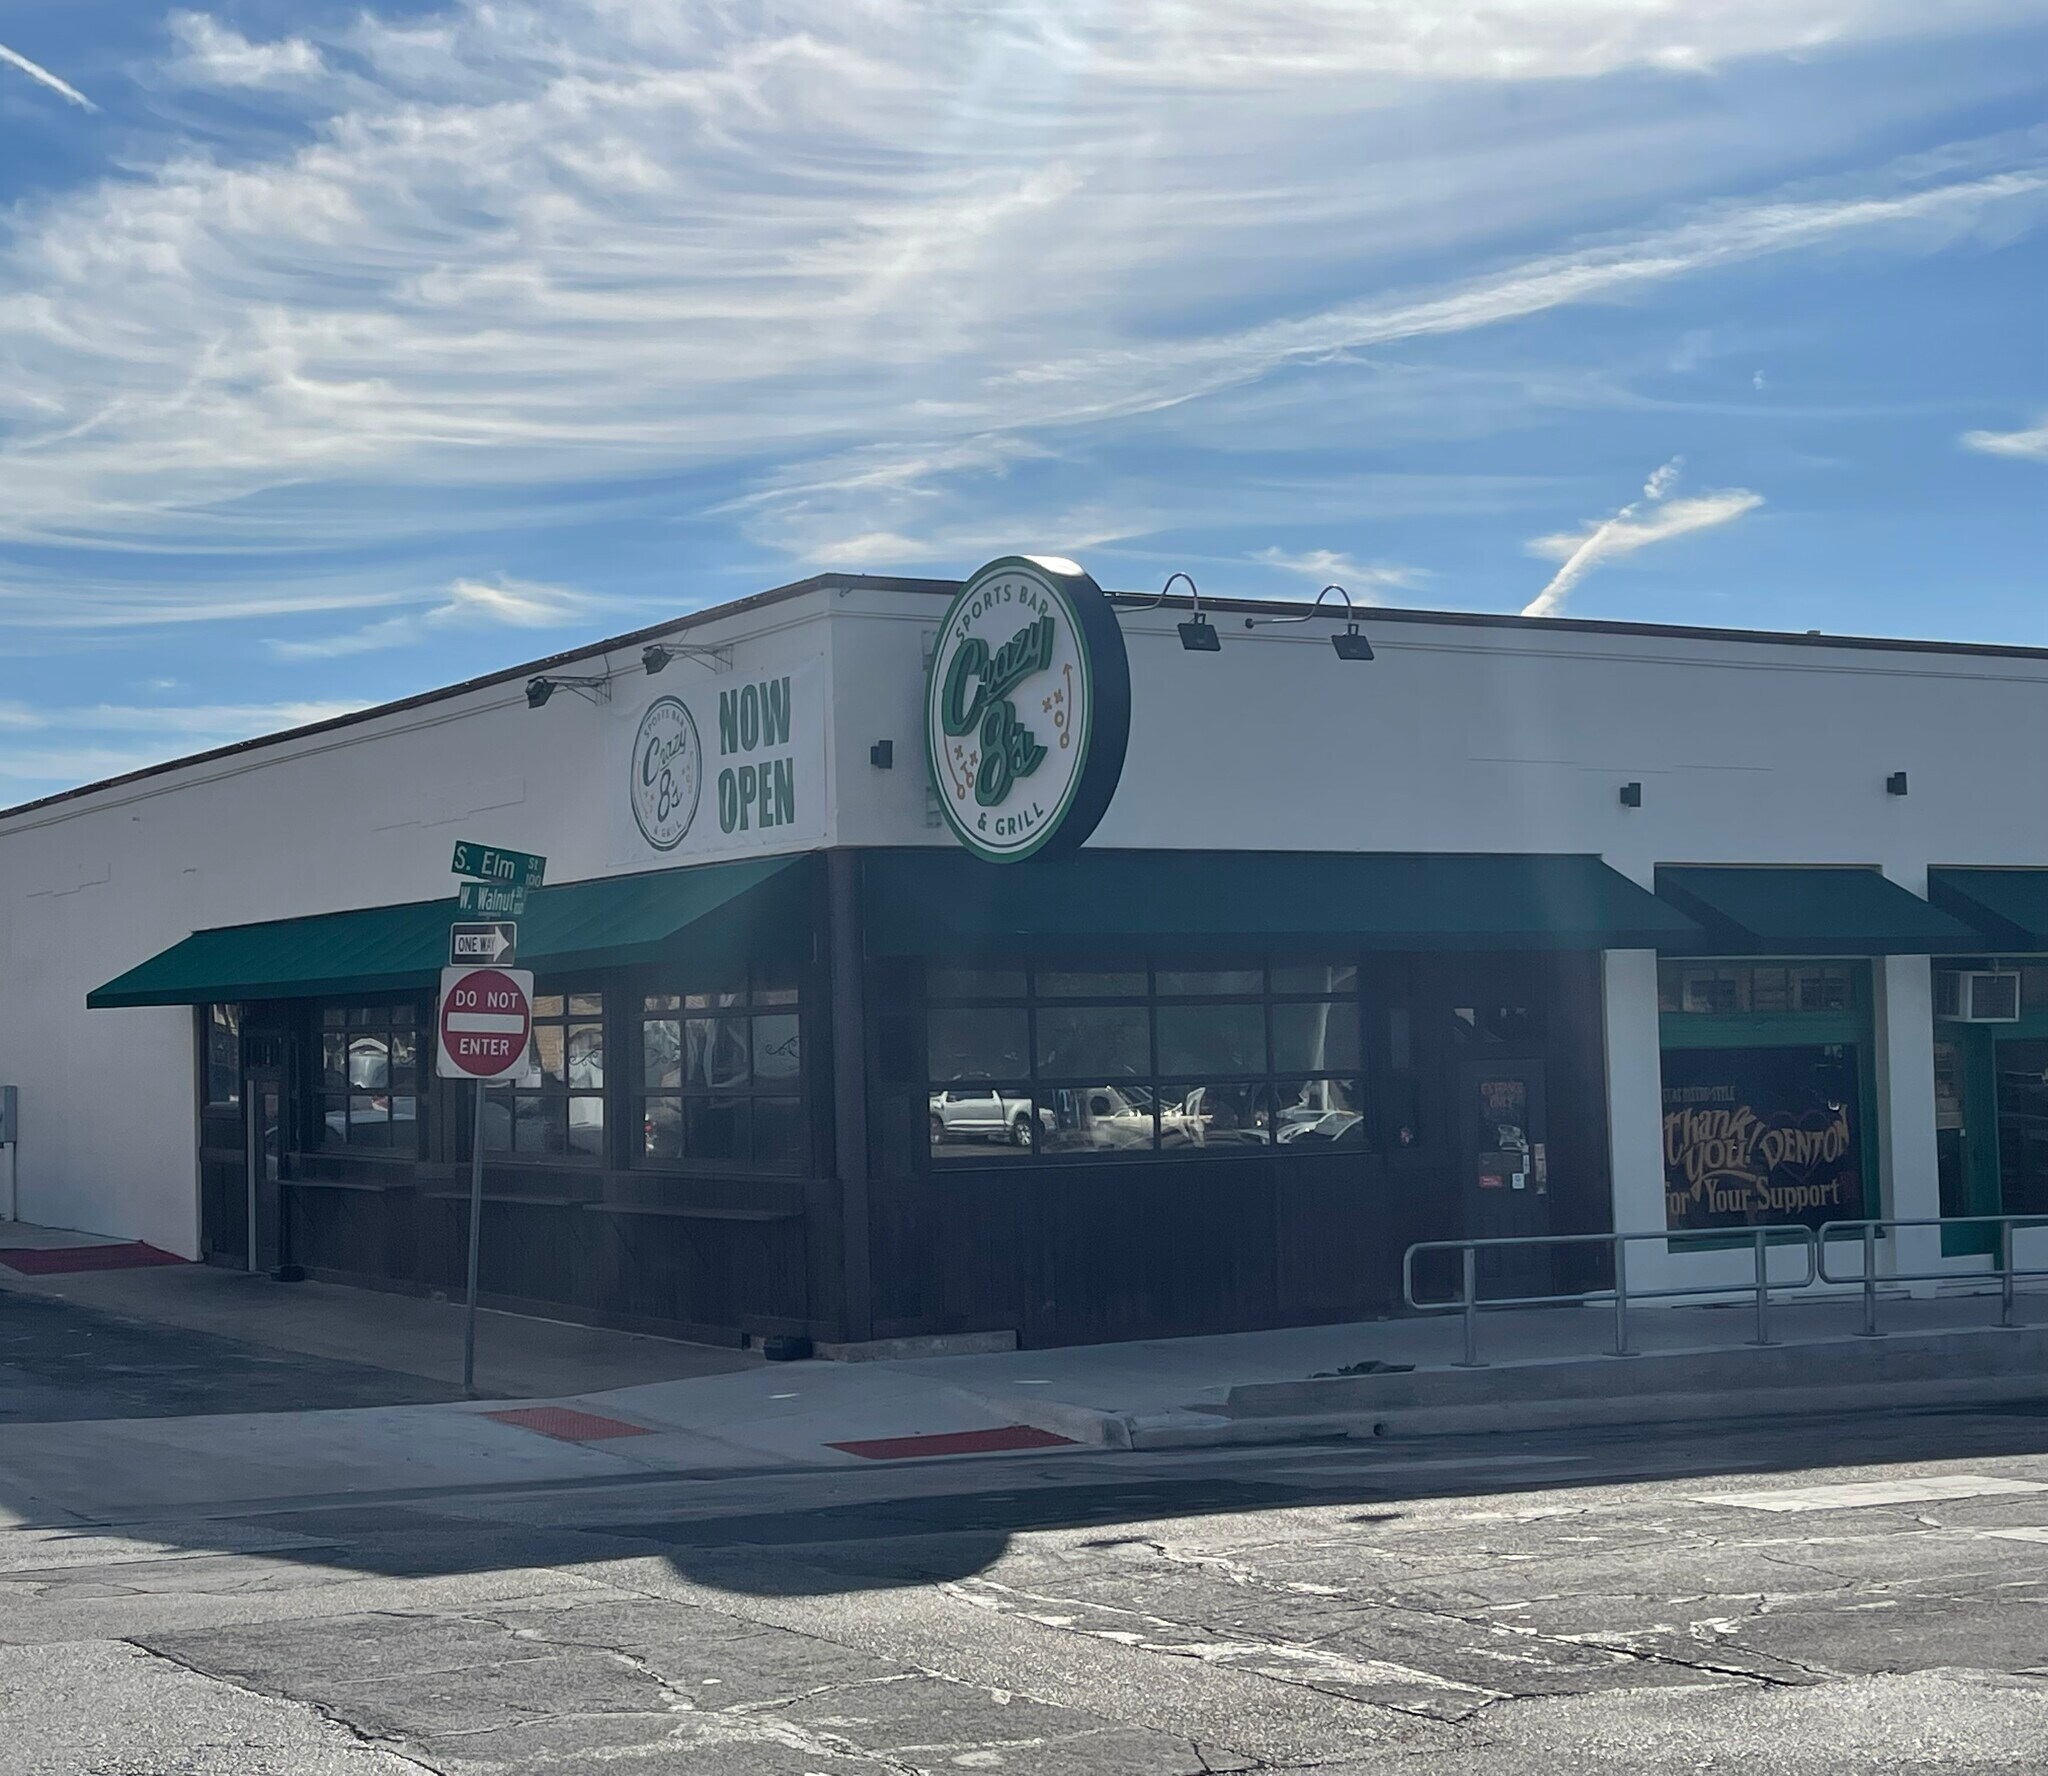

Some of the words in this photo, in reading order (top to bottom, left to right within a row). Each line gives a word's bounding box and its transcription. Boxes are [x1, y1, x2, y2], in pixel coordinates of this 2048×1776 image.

[955, 584, 1012, 642] SPORTS
[1018, 585, 1049, 617] BAR
[942, 616, 1055, 737] Crazy
[719, 676, 791, 756] NOW
[718, 757, 795, 834] OPEN
[977, 811, 987, 831] &
[995, 802, 1044, 836] GRILL
[454, 846, 471, 871] S.
[481, 851, 515, 880] Elm
[525, 873, 541, 888] 100
[460, 886, 472, 910] W.
[478, 887, 515, 911] Walnut
[458, 937, 478, 953] ONE
[479, 937, 496, 953] WAY
[455, 990, 477, 1007] DO
[487, 992, 519, 1009] NOT
[459, 1038, 510, 1056] ENTER
[1759, 1104, 1850, 1171] DENTON
[1704, 1178, 1750, 1214] Your
[1755, 1176, 1840, 1215] Support
